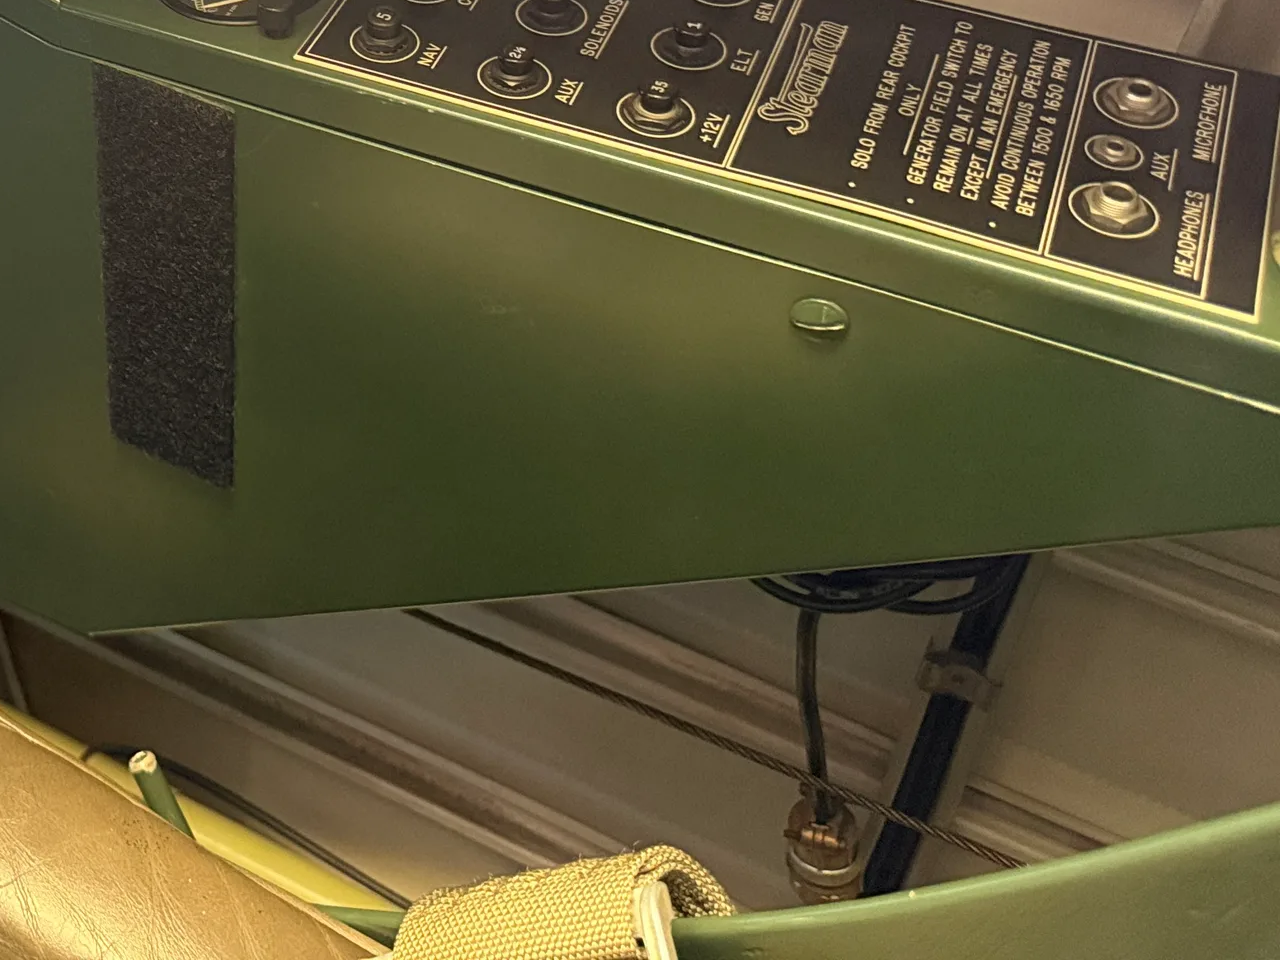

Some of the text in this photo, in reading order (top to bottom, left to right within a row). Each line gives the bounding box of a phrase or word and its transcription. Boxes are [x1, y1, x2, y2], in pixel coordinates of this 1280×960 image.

[376, 12, 392, 21] 5
[687, 21, 703, 30] 1
[754, 1, 771, 22] GEN
[416, 43, 443, 67] NAV
[730, 48, 753, 73] ELT
[554, 78, 579, 104] AUX
[650, 80, 669, 93] 35
[757, 20, 849, 136] Stearman
[850, 23, 917, 170] SOLO FROM REAR COCKPIT
[898, 83, 922, 117] ONLY
[906, 21, 974, 185] GENERATOR FIELD SWITCH TO
[699, 112, 724, 143] +12V
[933, 43, 994, 193] REMAIN ON AT ALL TIMES
[960, 49, 1018, 201] EXCEPT IN AN EMERGENCY
[990, 40, 1052, 211] AVOID CONTINUOUS OPERATION
[1015, 56, 1072, 217] BETWEEN 1500 & 1650 RPM
[1150, 152, 1171, 181] AUX
[1173, 190, 1204, 278] HEADPHONES
